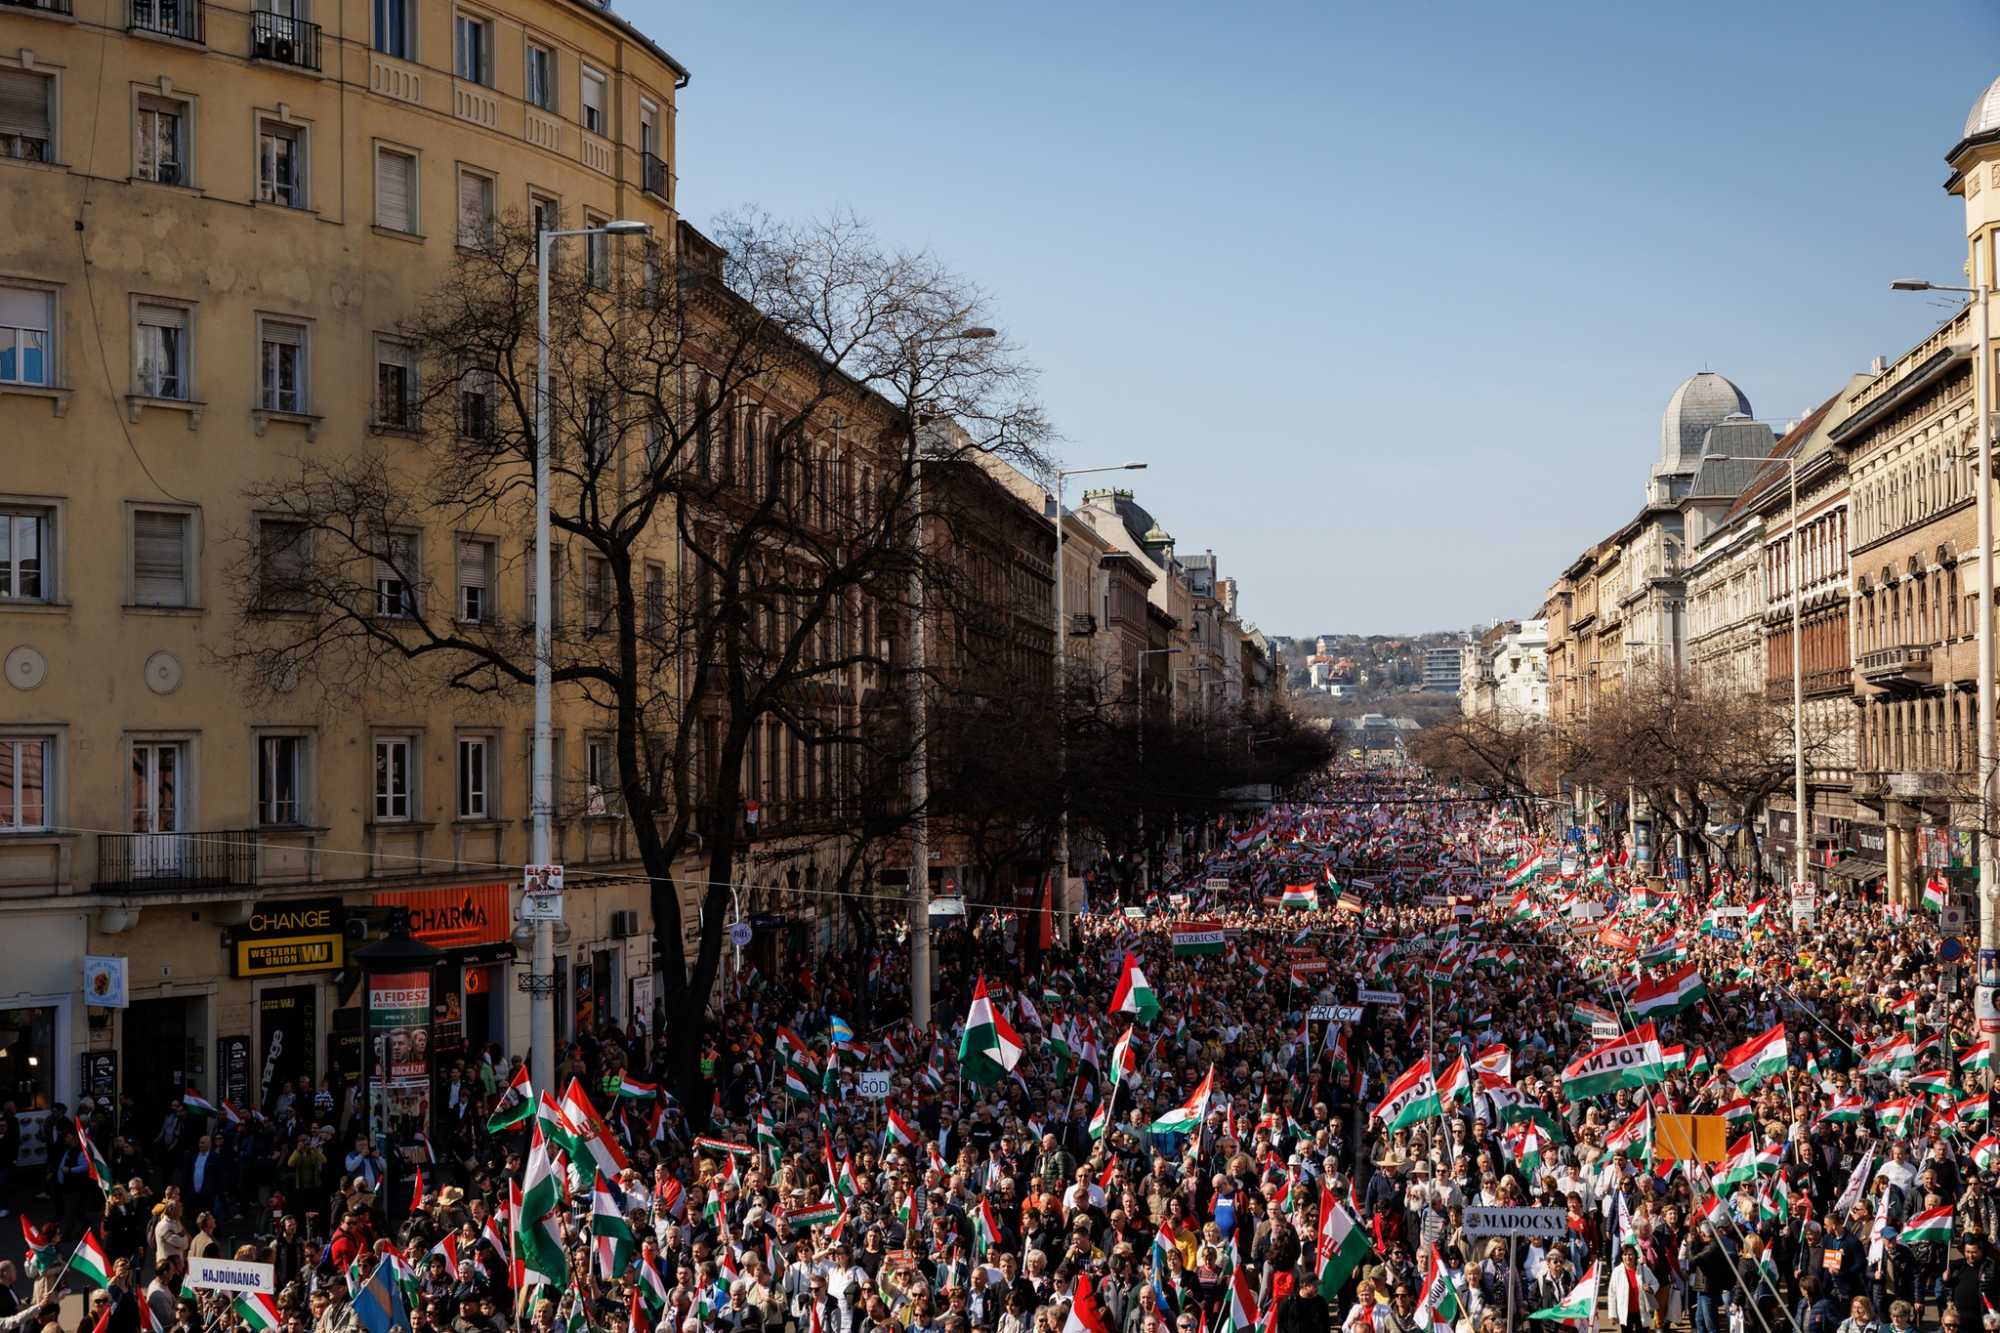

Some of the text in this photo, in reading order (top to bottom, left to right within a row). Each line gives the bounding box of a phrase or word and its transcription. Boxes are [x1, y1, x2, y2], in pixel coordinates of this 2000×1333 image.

[250, 910, 331, 932] CHANGE
[251, 944, 328, 962] WESTERN WU
[265, 954, 297, 966] UNION
[384, 990, 427, 1002] FIDESZ
[861, 1078, 888, 1093] GÖD
[1482, 1213, 1563, 1230] MADOCSA
[202, 1266, 261, 1287] HAJDÚNÁNÁS
